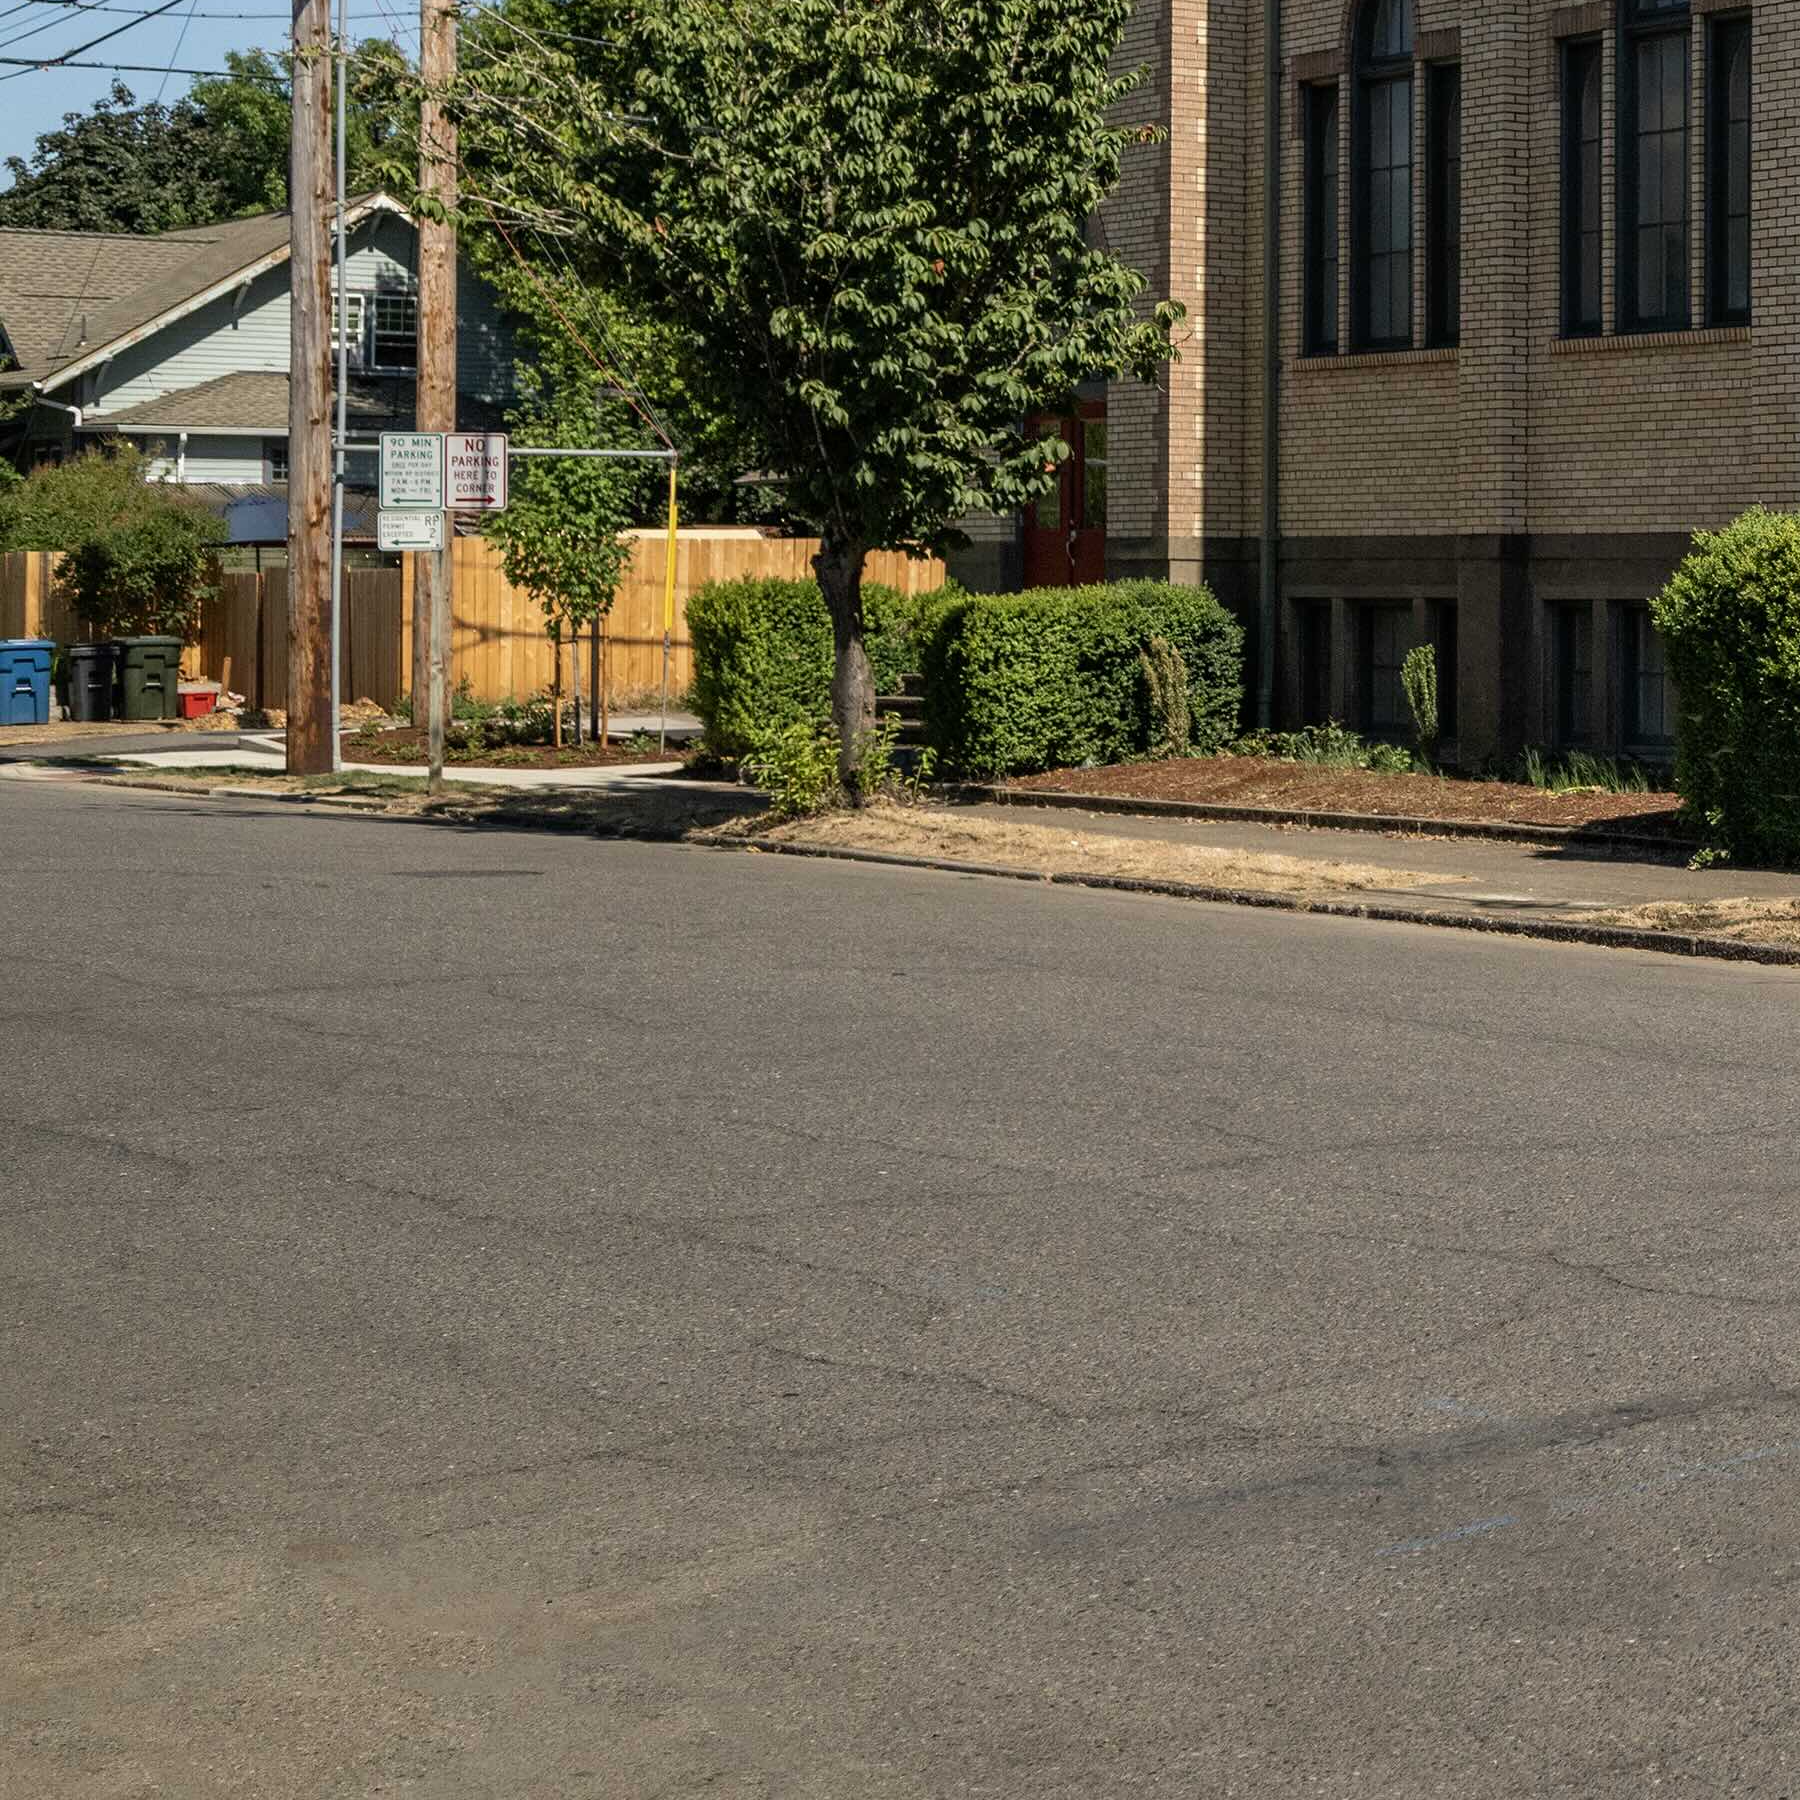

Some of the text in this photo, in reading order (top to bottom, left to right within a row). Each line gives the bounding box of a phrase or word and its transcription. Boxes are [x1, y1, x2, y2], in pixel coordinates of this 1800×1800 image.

[390, 438, 432, 447] 90 MIN
[464, 439, 486, 453] NO
[391, 450, 433, 460] PARKING
[451, 456, 499, 467] PARKING
[454, 471, 497, 480] HERE TO
[456, 484, 495, 493] CORNER
[424, 515, 439, 527] RP
[429, 527, 436, 538] 2
